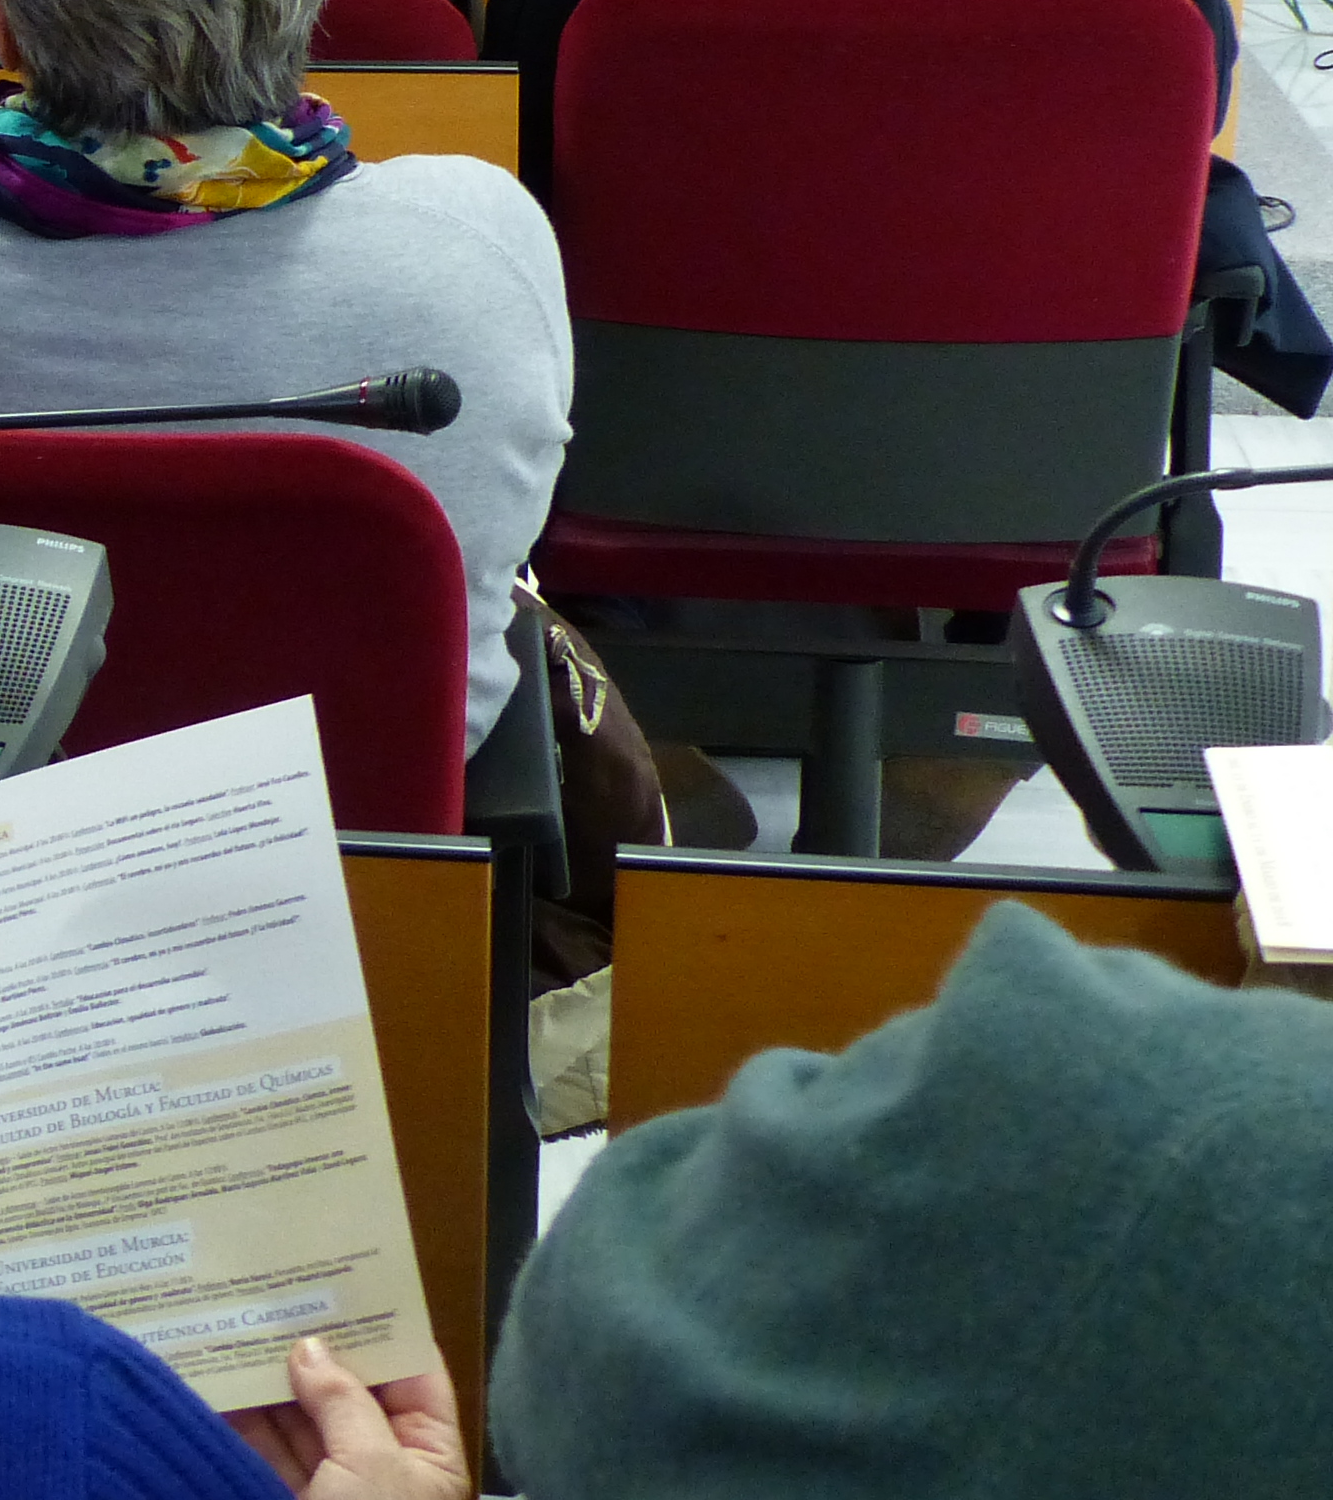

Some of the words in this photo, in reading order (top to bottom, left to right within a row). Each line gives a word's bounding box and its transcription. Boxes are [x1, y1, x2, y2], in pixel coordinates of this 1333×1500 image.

[36, 537, 85, 553] PHILIPS
[47, 1120, 65, 1133] DE
[145, 1102, 155, 1114] Y
[159, 1088, 232, 1112] FACULTAD
[237, 1083, 256, 1097] DE
[72, 1097, 91, 1109] DE
[98, 1245, 118, 1258] DE
[71, 1270, 93, 1284] DE
[96, 1252, 186, 1279] EDUCACIÓN
[217, 1317, 237, 1330] DE
[241, 1300, 330, 1326] CARTAGENA
